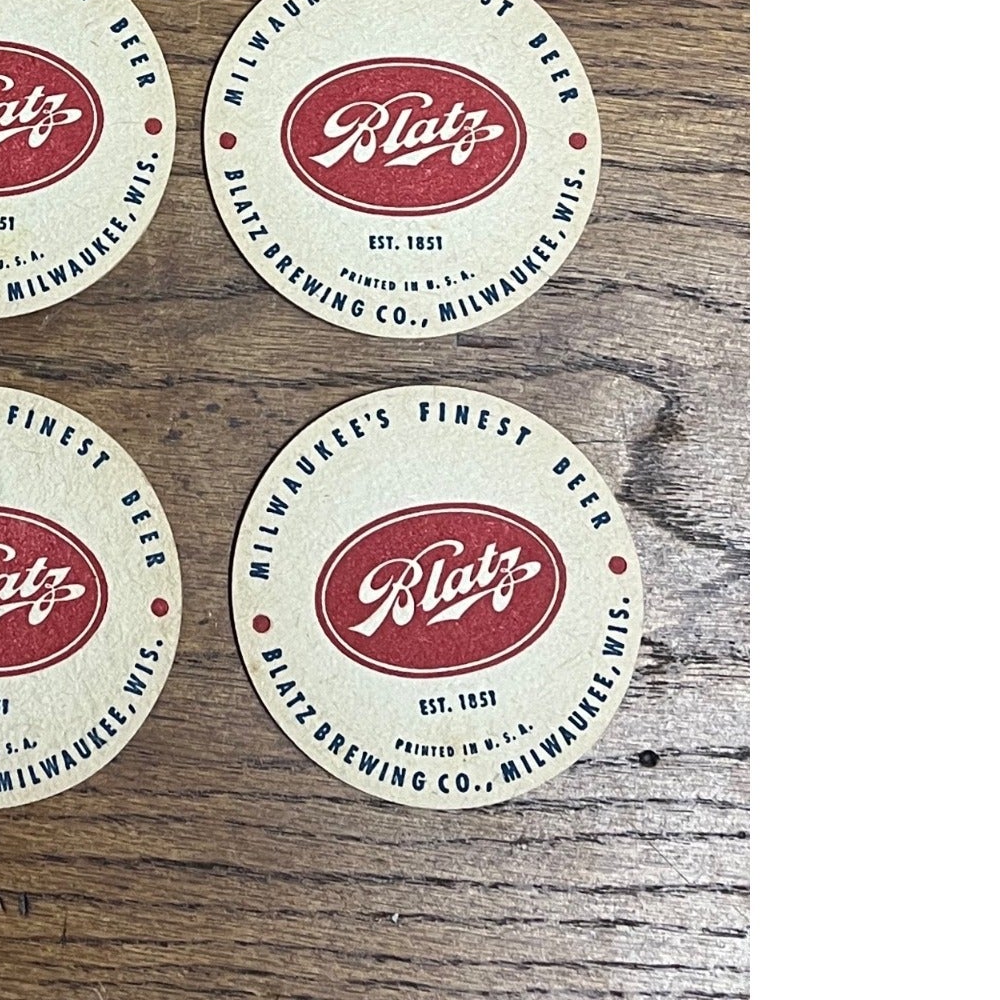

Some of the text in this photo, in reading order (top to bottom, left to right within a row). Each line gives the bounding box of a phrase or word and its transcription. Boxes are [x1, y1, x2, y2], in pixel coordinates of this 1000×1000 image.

[110, 18, 155, 88] BEER
[529, 33, 578, 103] BEER
[309, 92, 504, 168] Blatz
[8, 213, 136, 301] MILWAUKEE,
[124, 153, 158, 205] WIS.
[224, 169, 585, 328] BLATZ BREWING CO., MILWAUKEE, WIS.
[369, 236, 442, 250] EST. 1851
[340, 268, 396, 290] PRINTED
[7, 405, 110, 469] FINEST
[122, 490, 165, 567] BEER
[249, 402, 611, 580] MILWAUKEE'S FINEST BEER
[348, 540, 541, 636] Blatz
[123, 640, 163, 696] WIS.
[262, 598, 629, 793] BLATZ BREWING CO., MILWAUKEE, WIS.
[419, 690, 496, 715] EST. 1851
[395, 738, 478, 757] PRINTED IN
